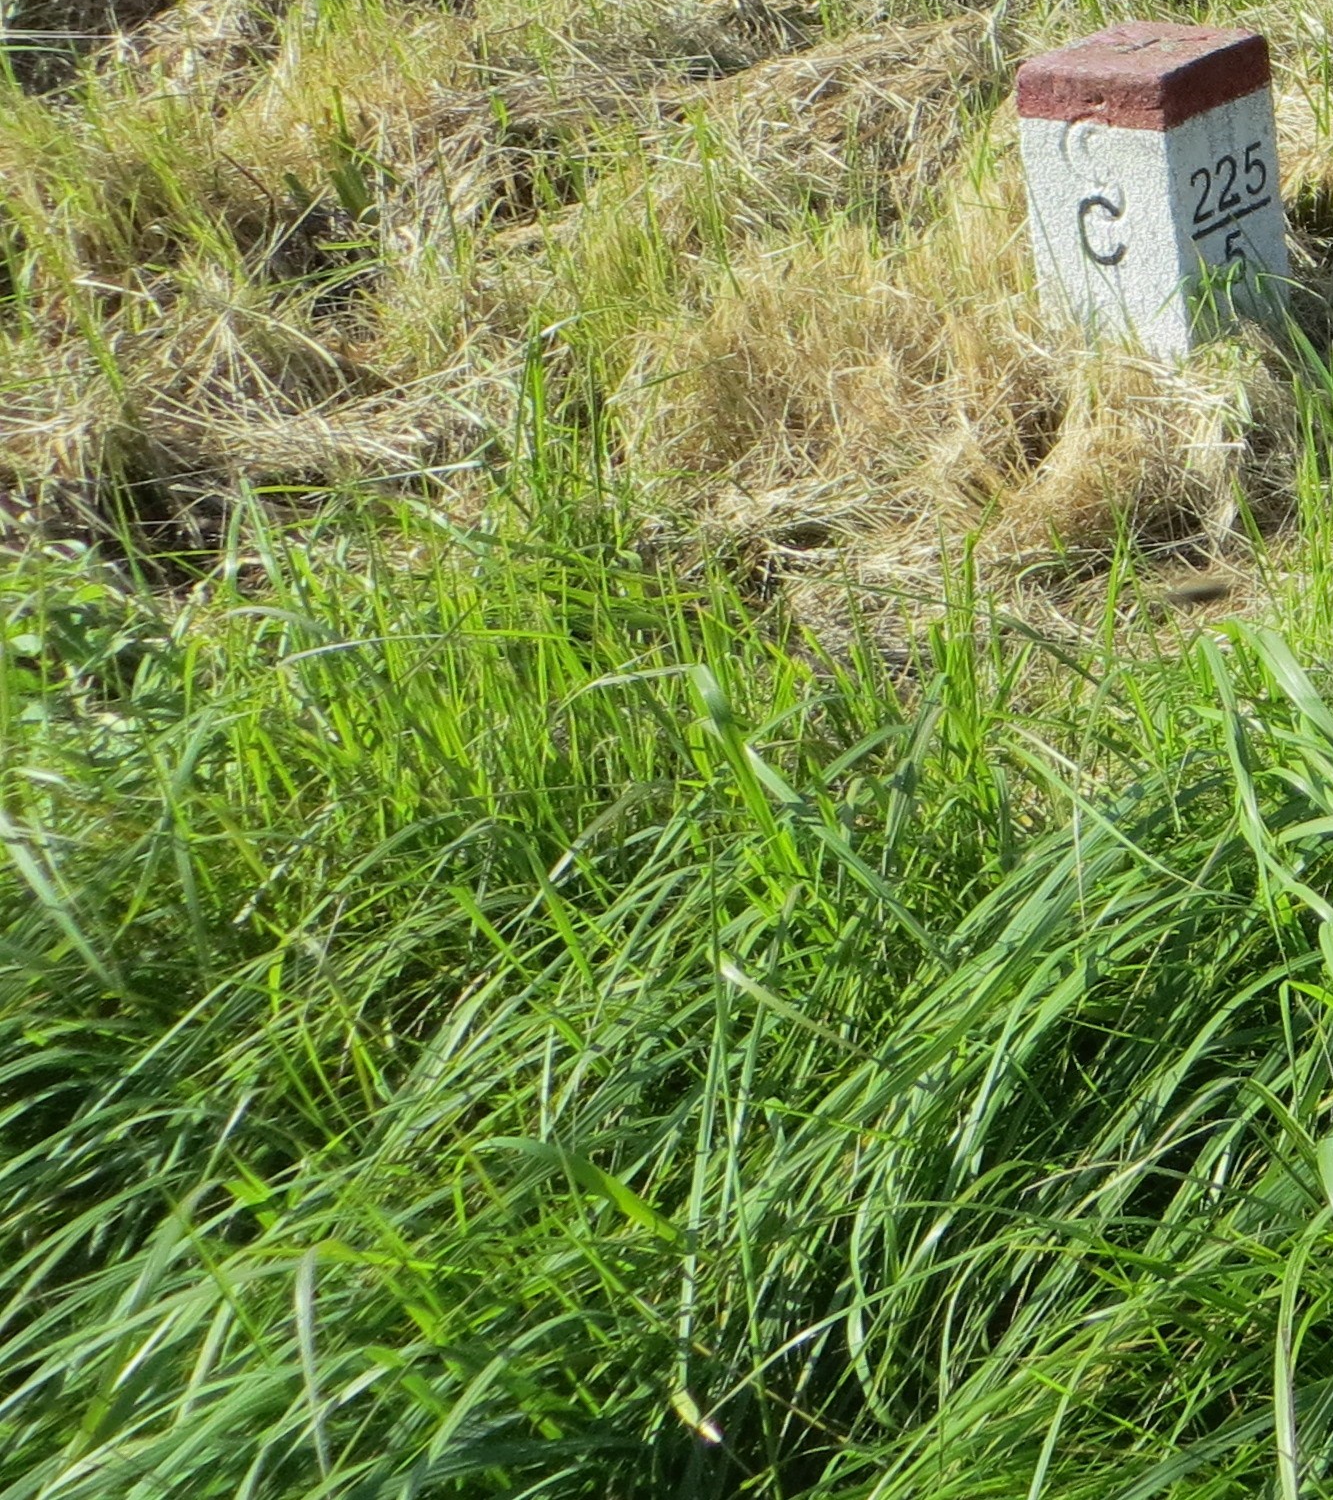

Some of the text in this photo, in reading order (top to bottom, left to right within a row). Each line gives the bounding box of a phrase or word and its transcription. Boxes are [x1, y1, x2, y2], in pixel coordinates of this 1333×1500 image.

[1190, 141, 1267, 225] 225
[1078, 195, 1127, 266] C
[1224, 229, 1247, 285] 5
